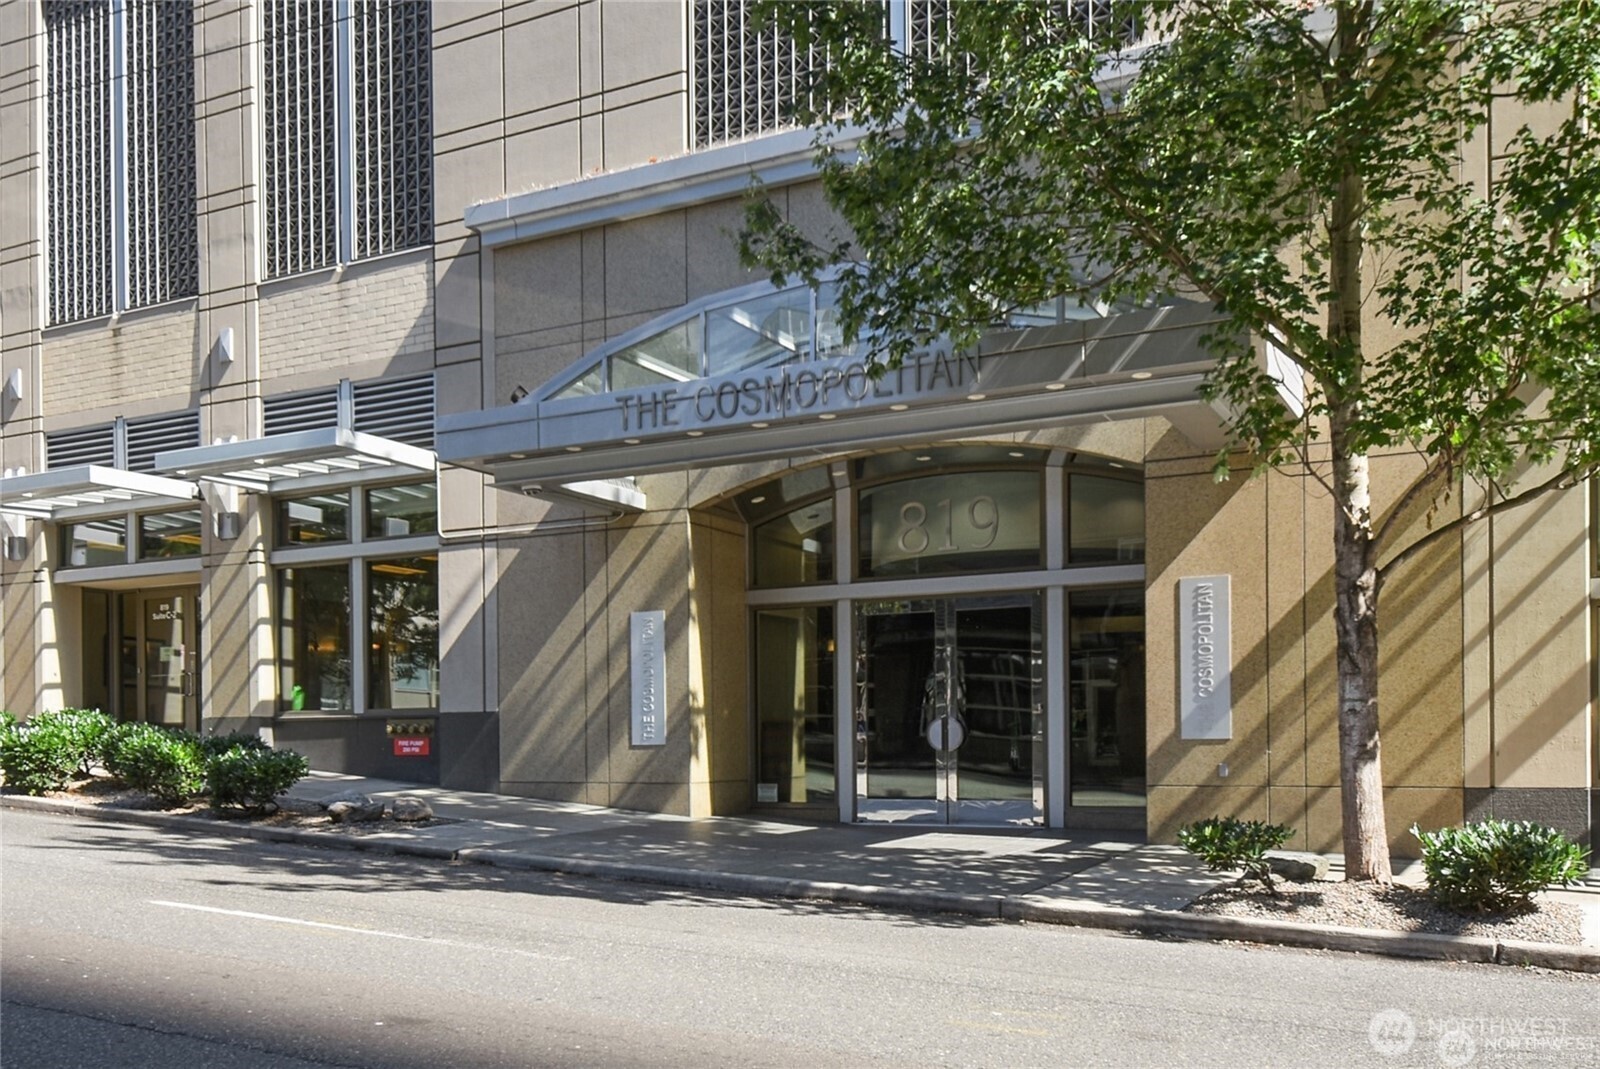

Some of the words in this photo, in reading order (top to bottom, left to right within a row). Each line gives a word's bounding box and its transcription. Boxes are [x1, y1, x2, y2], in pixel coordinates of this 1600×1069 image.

[615, 388, 679, 431] THE
[694, 345, 981, 422] COSMOPOLITAN
[898, 495, 999, 553] 819
[1197, 582, 1215, 698] COSMOPOLITAN
[642, 714, 655, 741] THE
